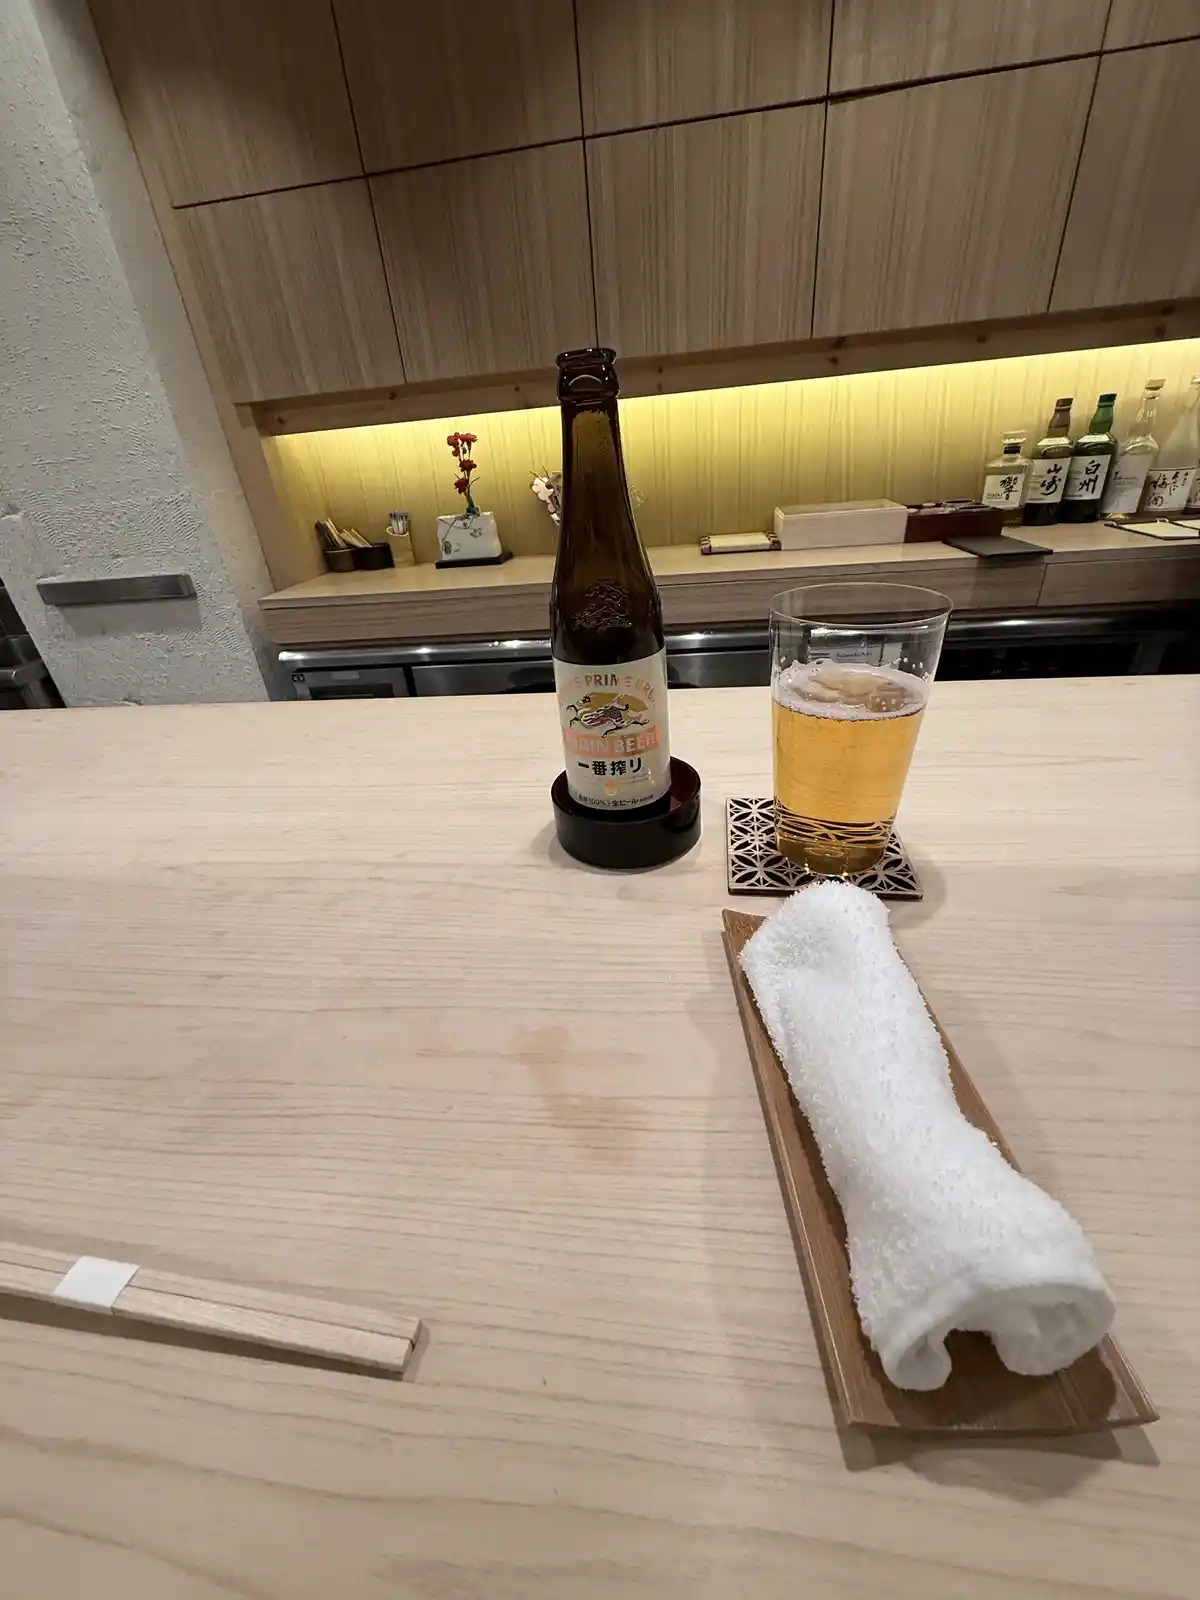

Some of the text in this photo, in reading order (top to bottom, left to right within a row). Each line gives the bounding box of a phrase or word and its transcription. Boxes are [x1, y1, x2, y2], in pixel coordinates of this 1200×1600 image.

[1041, 463, 1062, 496] 山崎
[1078, 460, 1100, 494] 白州
[613, 733, 656, 753] BEER
[578, 757, 642, 776] 一番搾り
